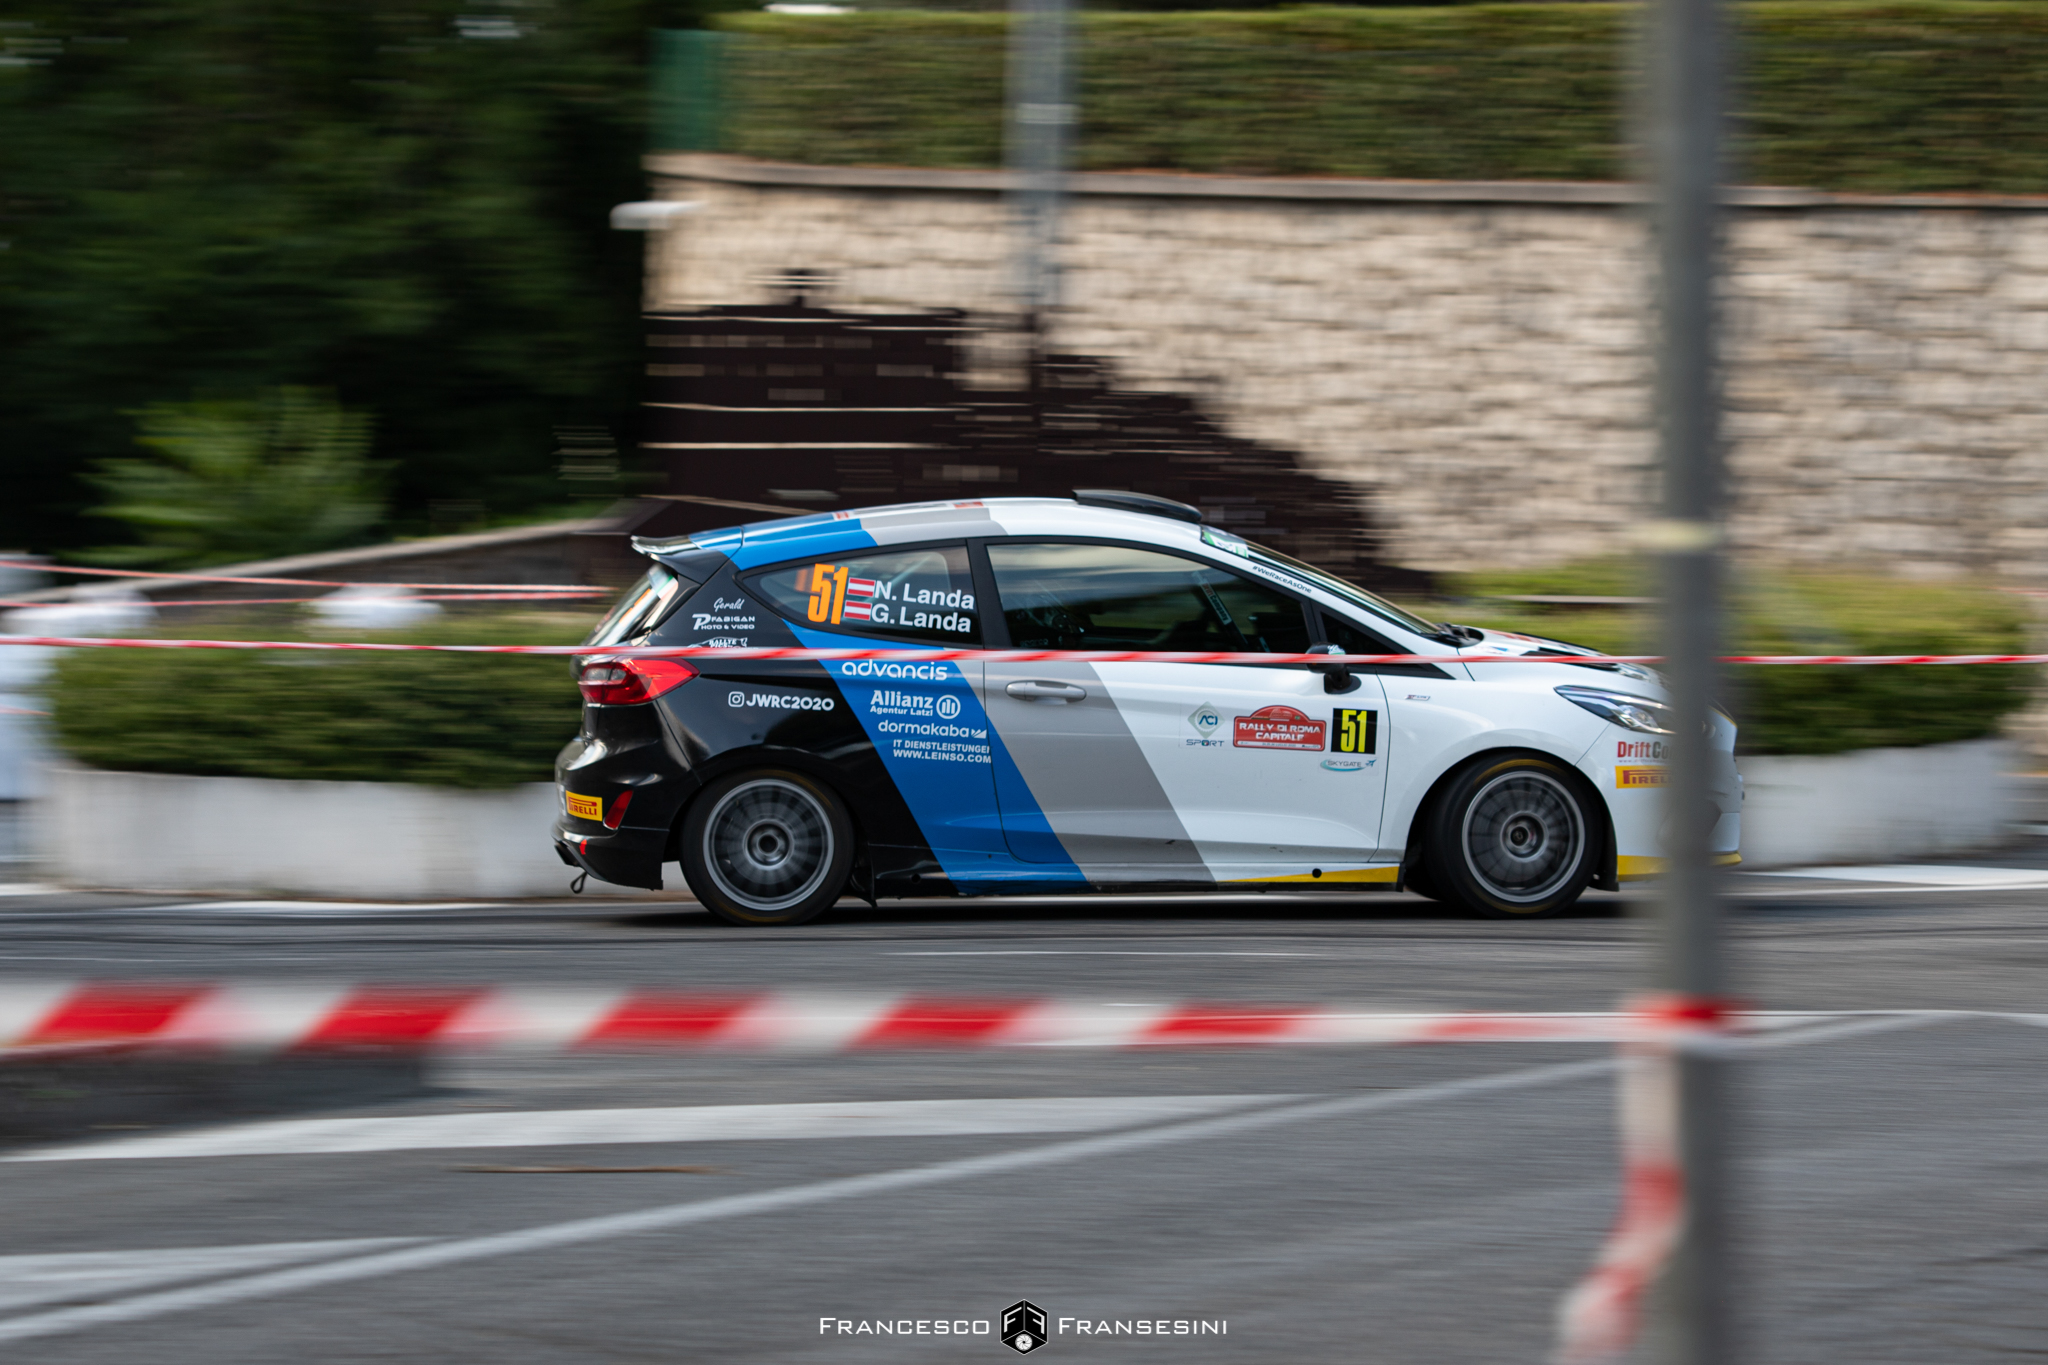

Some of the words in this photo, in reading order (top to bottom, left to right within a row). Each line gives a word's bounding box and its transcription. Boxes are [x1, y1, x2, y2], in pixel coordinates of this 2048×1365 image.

[1252, 565, 1312, 594] #WeRaceAsOne
[807, 563, 849, 625] 51
[875, 580, 897, 600] N.
[903, 583, 975, 610] Landa
[713, 597, 745, 612] Gerald
[871, 603, 896, 624] G.
[899, 607, 971, 633] Landa
[841, 659, 948, 681] advancis
[746, 693, 835, 711] JWRC2020
[870, 690, 934, 709] Allianz
[870, 705, 908, 715] Agentur
[878, 720, 969, 738] dormakaba
[1198, 714, 1218, 726] ACI
[1239, 722, 1274, 732] RALLY
[1290, 725, 1321, 735] ROMA
[1340, 709, 1367, 753] 51
[893, 739, 902, 748] IT
[1186, 738, 1225, 748] SPORT
[893, 749, 992, 764] WWW.LEINSO.COM
[1327, 759, 1362, 768] SKYGATE
[568, 796, 597, 816] PIRELLI
